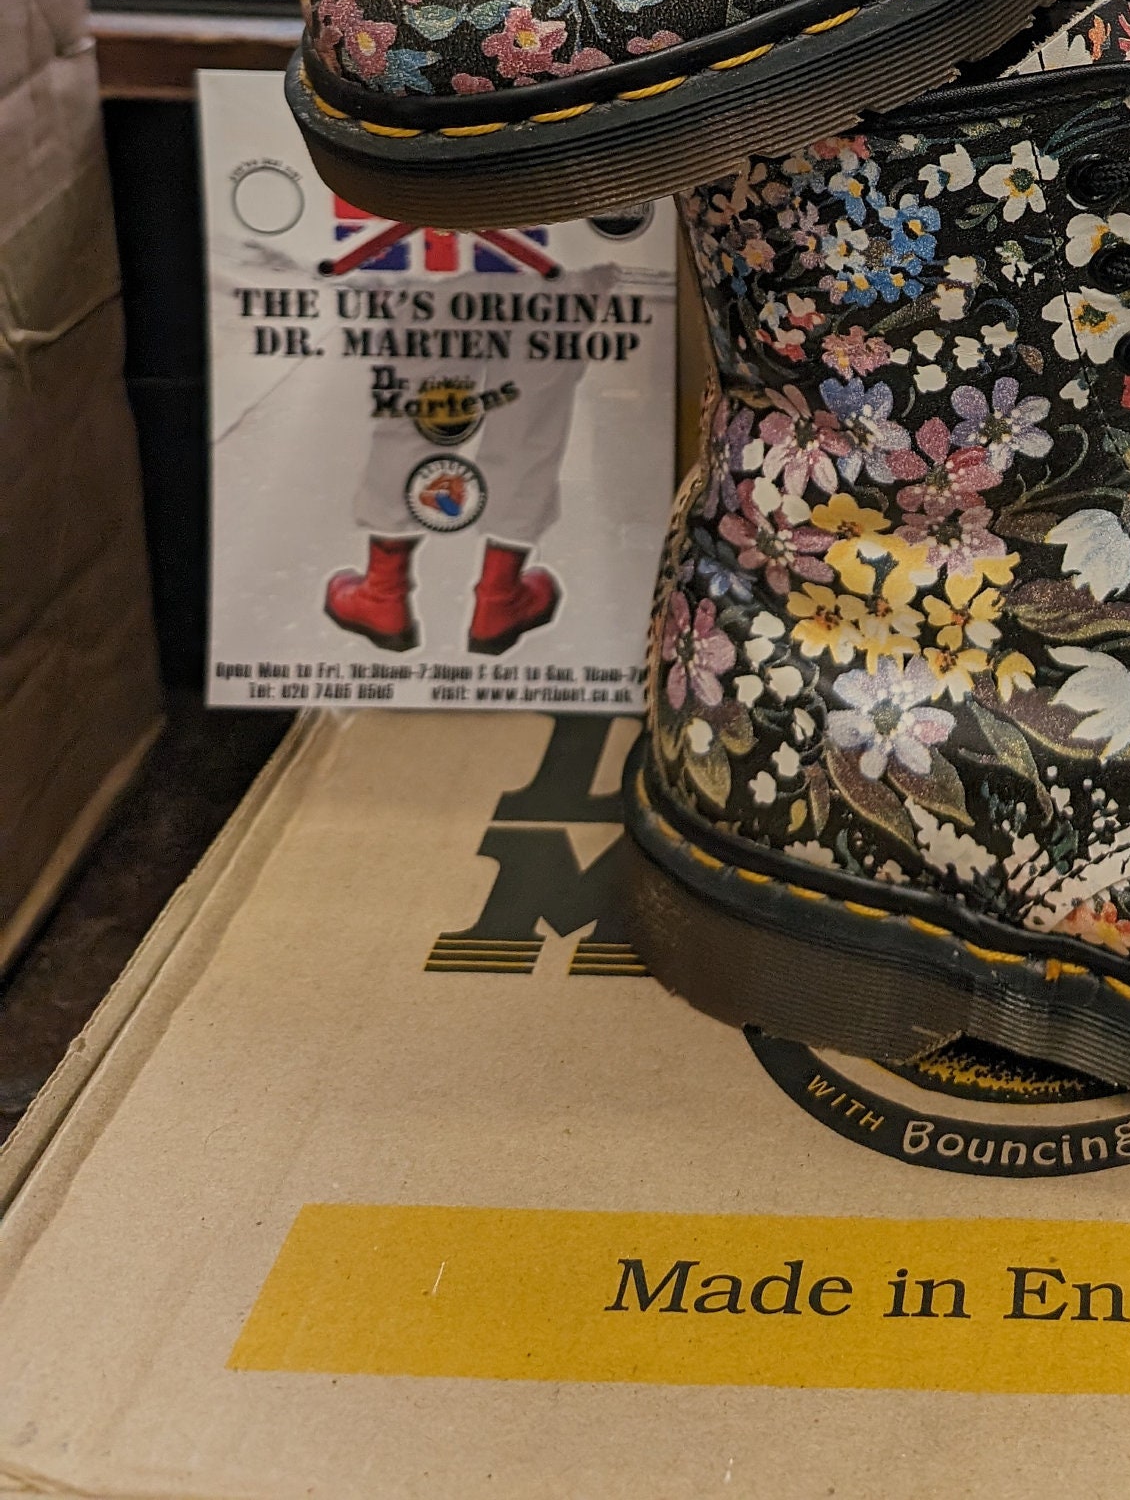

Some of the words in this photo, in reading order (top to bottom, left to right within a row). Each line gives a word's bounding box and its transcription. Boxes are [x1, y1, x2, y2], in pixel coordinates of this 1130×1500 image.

[235, 287, 320, 318] THE
[337, 289, 436, 322] UK'S
[450, 291, 653, 326] ORIGINAL
[254, 325, 325, 357] DR.
[343, 327, 512, 361] MARTEN
[528, 330, 641, 362] SHOP
[370, 380, 521, 419] Martens
[215, 661, 251, 680] Open
[258, 661, 291, 678] Mon
[296, 663, 313, 678] to
[806, 1073, 887, 1133] WITH
[606, 1257, 852, 1316] Made
[883, 1267, 971, 1318] in
